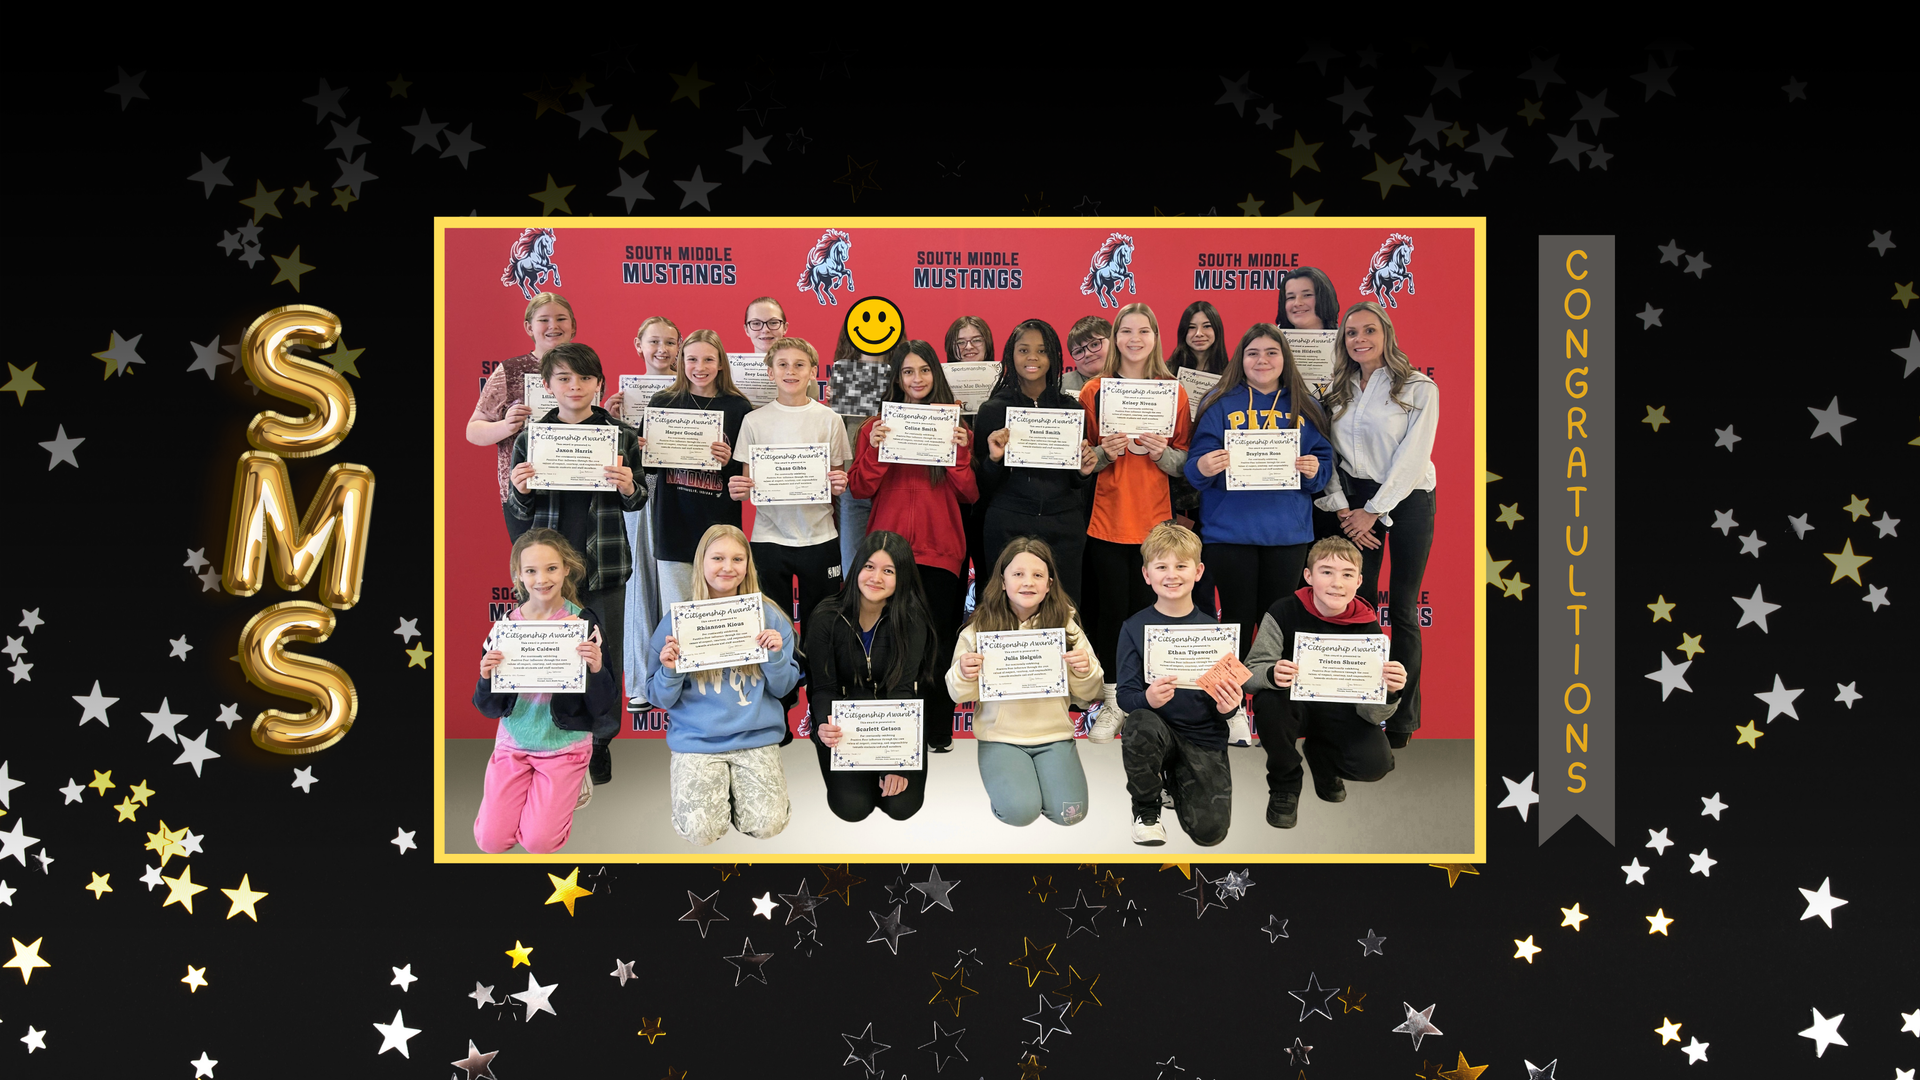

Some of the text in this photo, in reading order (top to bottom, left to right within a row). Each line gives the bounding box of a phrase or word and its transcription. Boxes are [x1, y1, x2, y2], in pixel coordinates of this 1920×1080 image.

[626, 246, 732, 261] SOUTH MIDDLE
[917, 251, 1019, 266] SOUTH MIDDLE
[1198, 253, 1299, 267] SOUTH MIDDLE
[622, 262, 736, 285] MUSTANGS
[914, 267, 1022, 290] MUSTANGS
[1194, 269, 1290, 290] MUSTAN
[727, 606, 752, 614] Award
